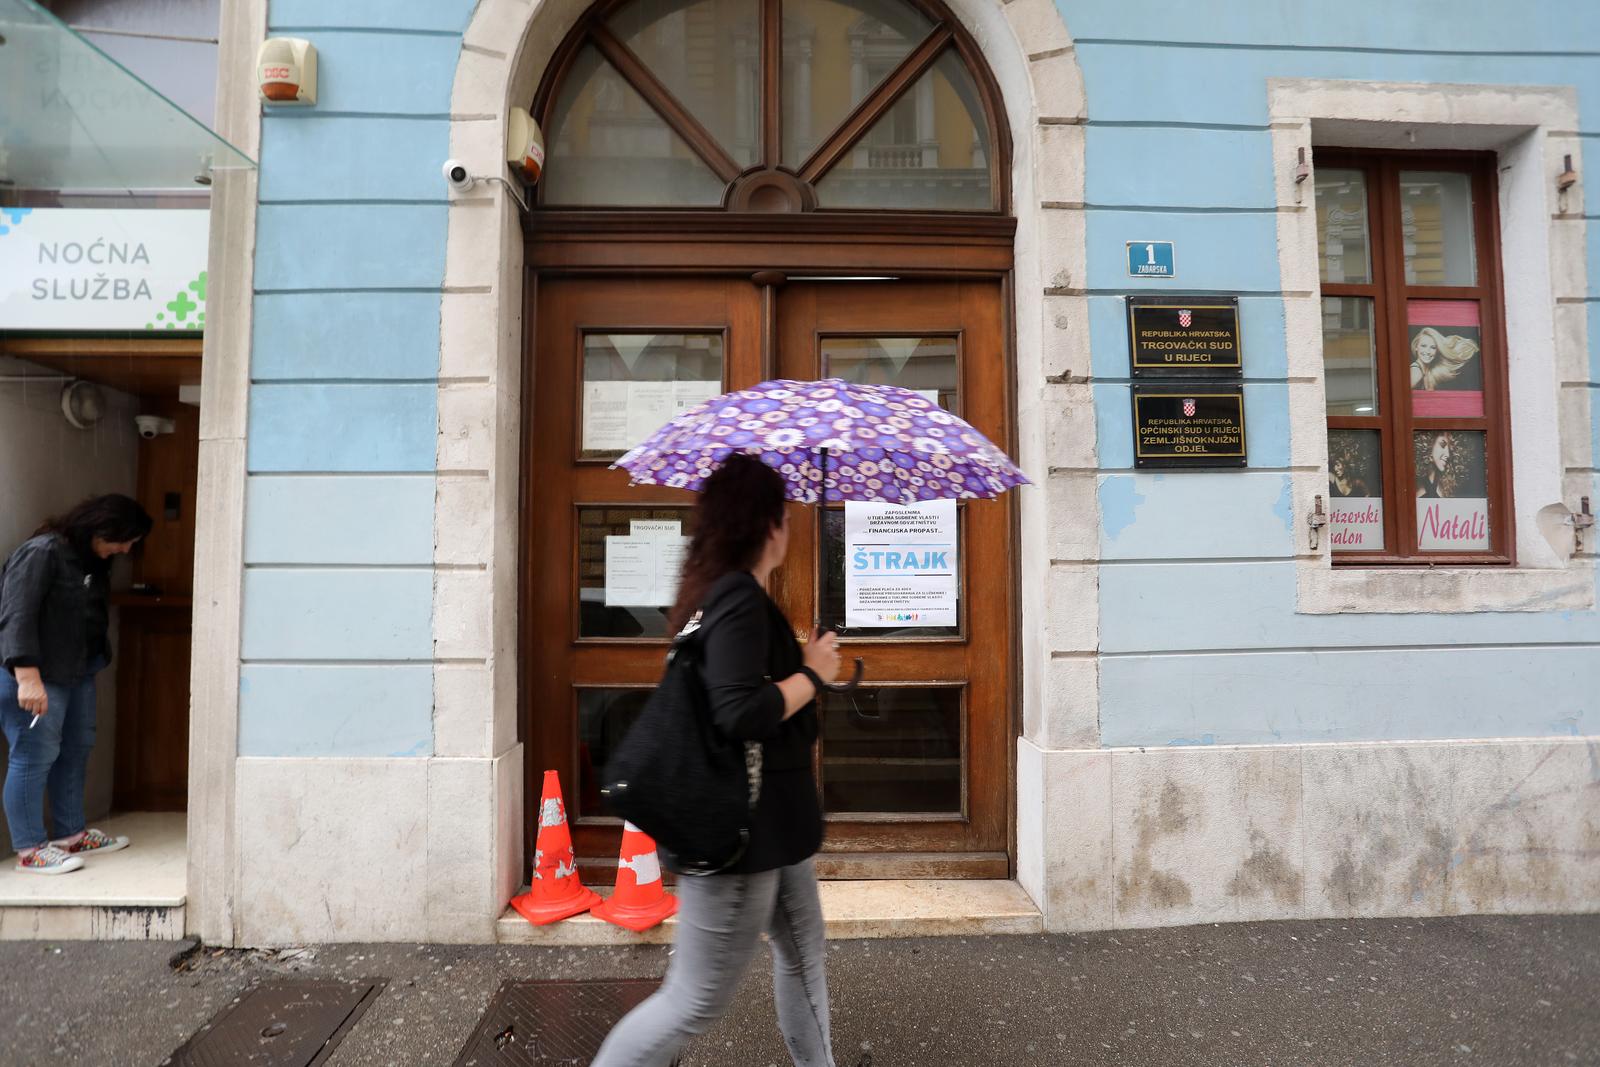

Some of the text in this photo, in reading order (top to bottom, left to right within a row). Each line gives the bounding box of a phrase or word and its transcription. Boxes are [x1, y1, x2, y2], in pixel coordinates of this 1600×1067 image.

[38, 237, 150, 264] NOĆNA
[1146, 244, 1156, 265] 1
[1137, 265, 1168, 274] ZADARSKA
[32, 273, 152, 300] SLUŽBA
[1141, 340, 1233, 350] TRGOVAČKI SUD
[1164, 353, 1212, 362] U RIJECI
[1184, 426, 1202, 434] SUD
[1204, 426, 1211, 434] U
[1213, 426, 1241, 434] RIJECI
[1143, 436, 1239, 445] ZEMLJIŠNOKNJIŽNI
[1174, 445, 1208, 453] ODJEL
[1329, 504, 1378, 523] rizerski
[1418, 503, 1485, 547] Natali
[853, 547, 948, 570] ŠTRAJK
